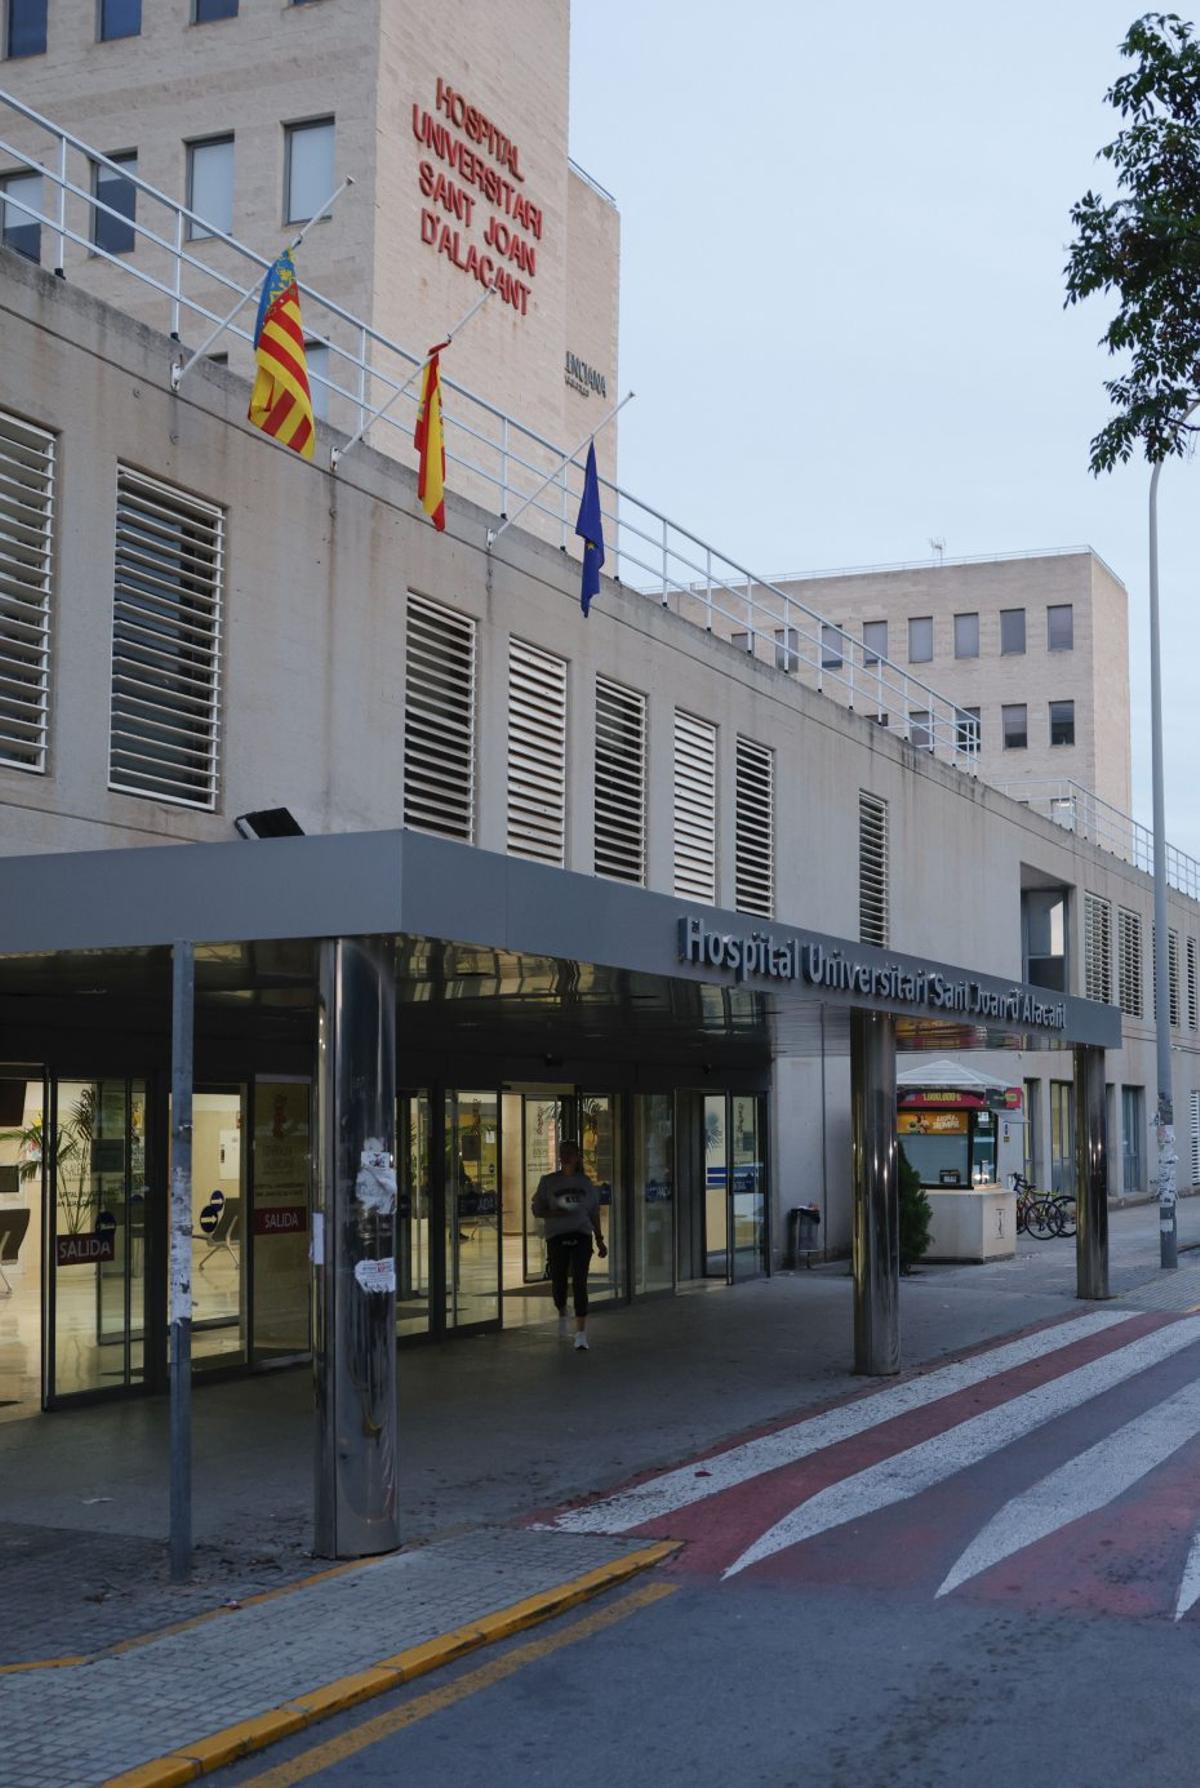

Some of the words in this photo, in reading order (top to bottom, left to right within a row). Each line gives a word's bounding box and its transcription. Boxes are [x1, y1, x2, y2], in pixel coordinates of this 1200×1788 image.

[412, 103, 543, 240] UNIVERSITARI
[436, 77, 525, 183] HOSPITAL
[418, 160, 475, 227] SANT
[484, 216, 536, 277] JOAN
[421, 207, 531, 315] D'ALACANT
[680, 915, 800, 982] Hospital
[807, 943, 929, 1004] Universitari
[933, 974, 969, 1011] Sant
[972, 982, 1007, 1019] Joan
[59, 1239, 111, 1259] SALIDA
[264, 1212, 299, 1228] SALIDA
